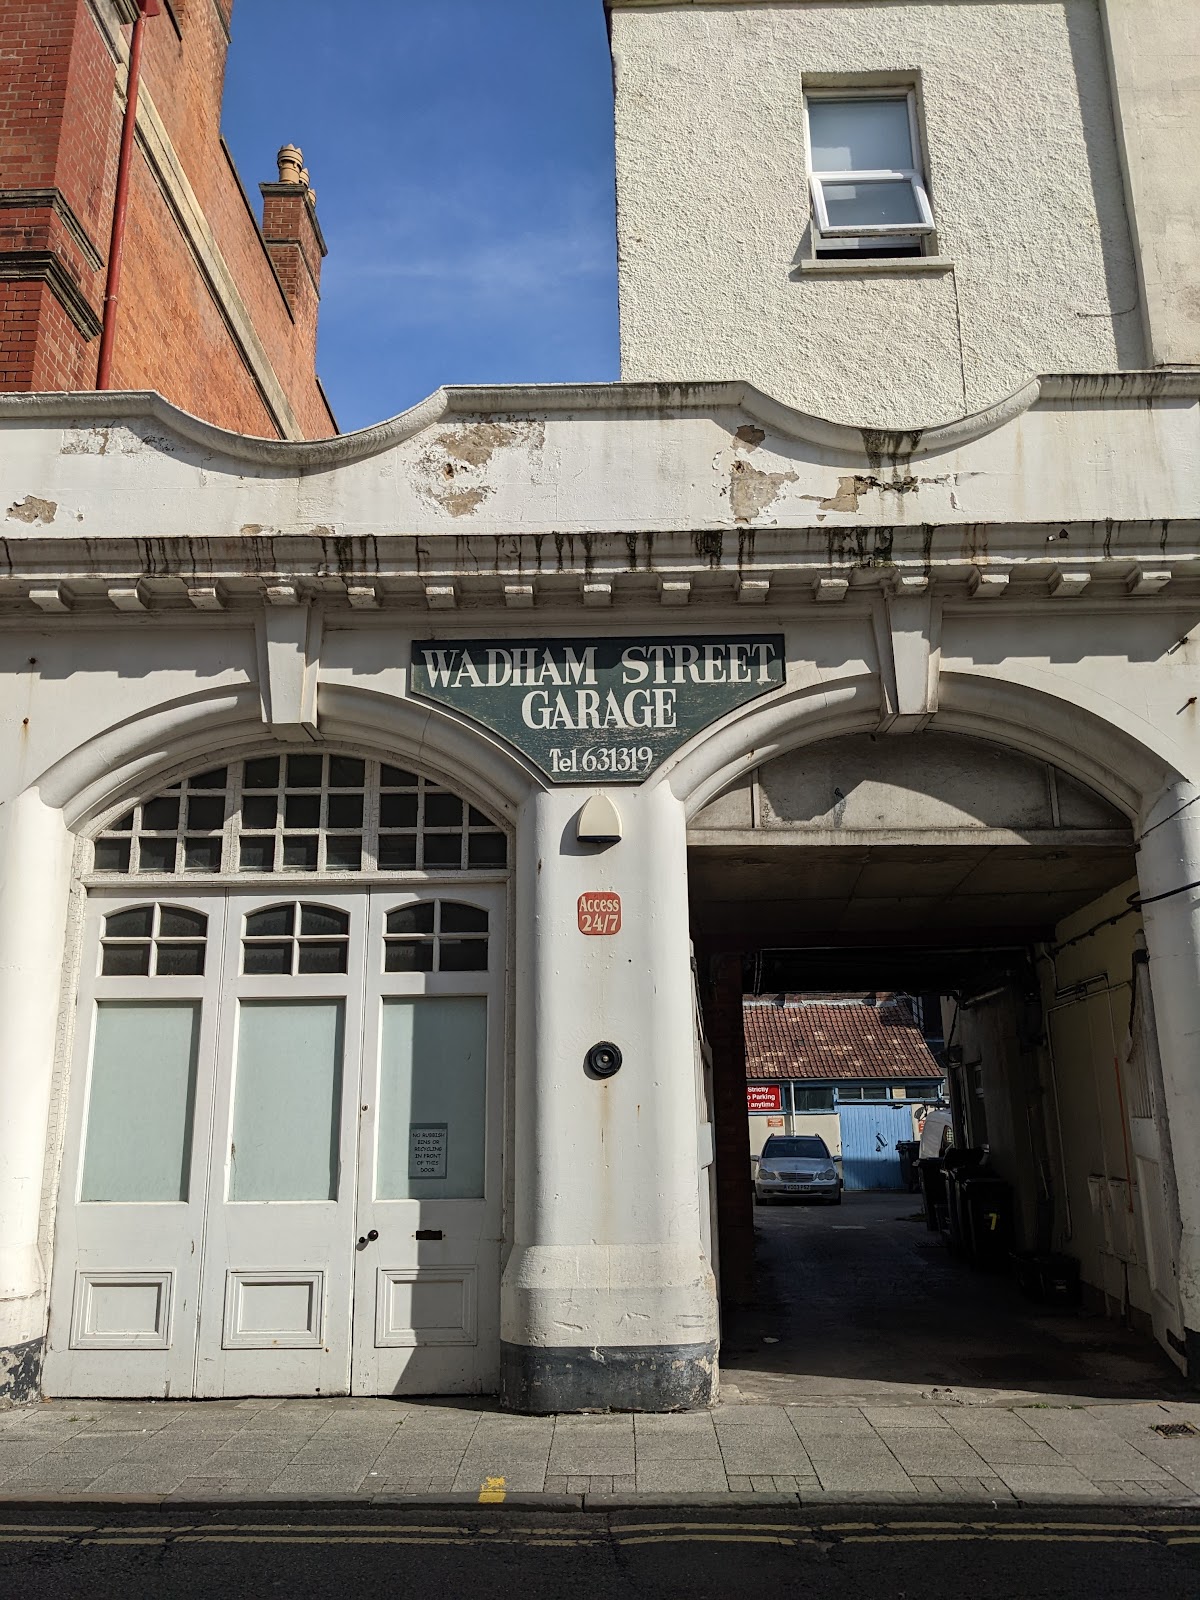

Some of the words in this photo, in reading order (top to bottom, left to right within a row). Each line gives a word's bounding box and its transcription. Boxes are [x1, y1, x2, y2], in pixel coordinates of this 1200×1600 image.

[421, 646, 598, 688] WADHAM
[622, 643, 775, 684] STREET
[521, 687, 677, 730] GARAGE
[582, 746, 653, 773] 631319
[579, 896, 620, 912] Access
[581, 913, 619, 934] 24/7
[989, 1213, 997, 1230] 7
